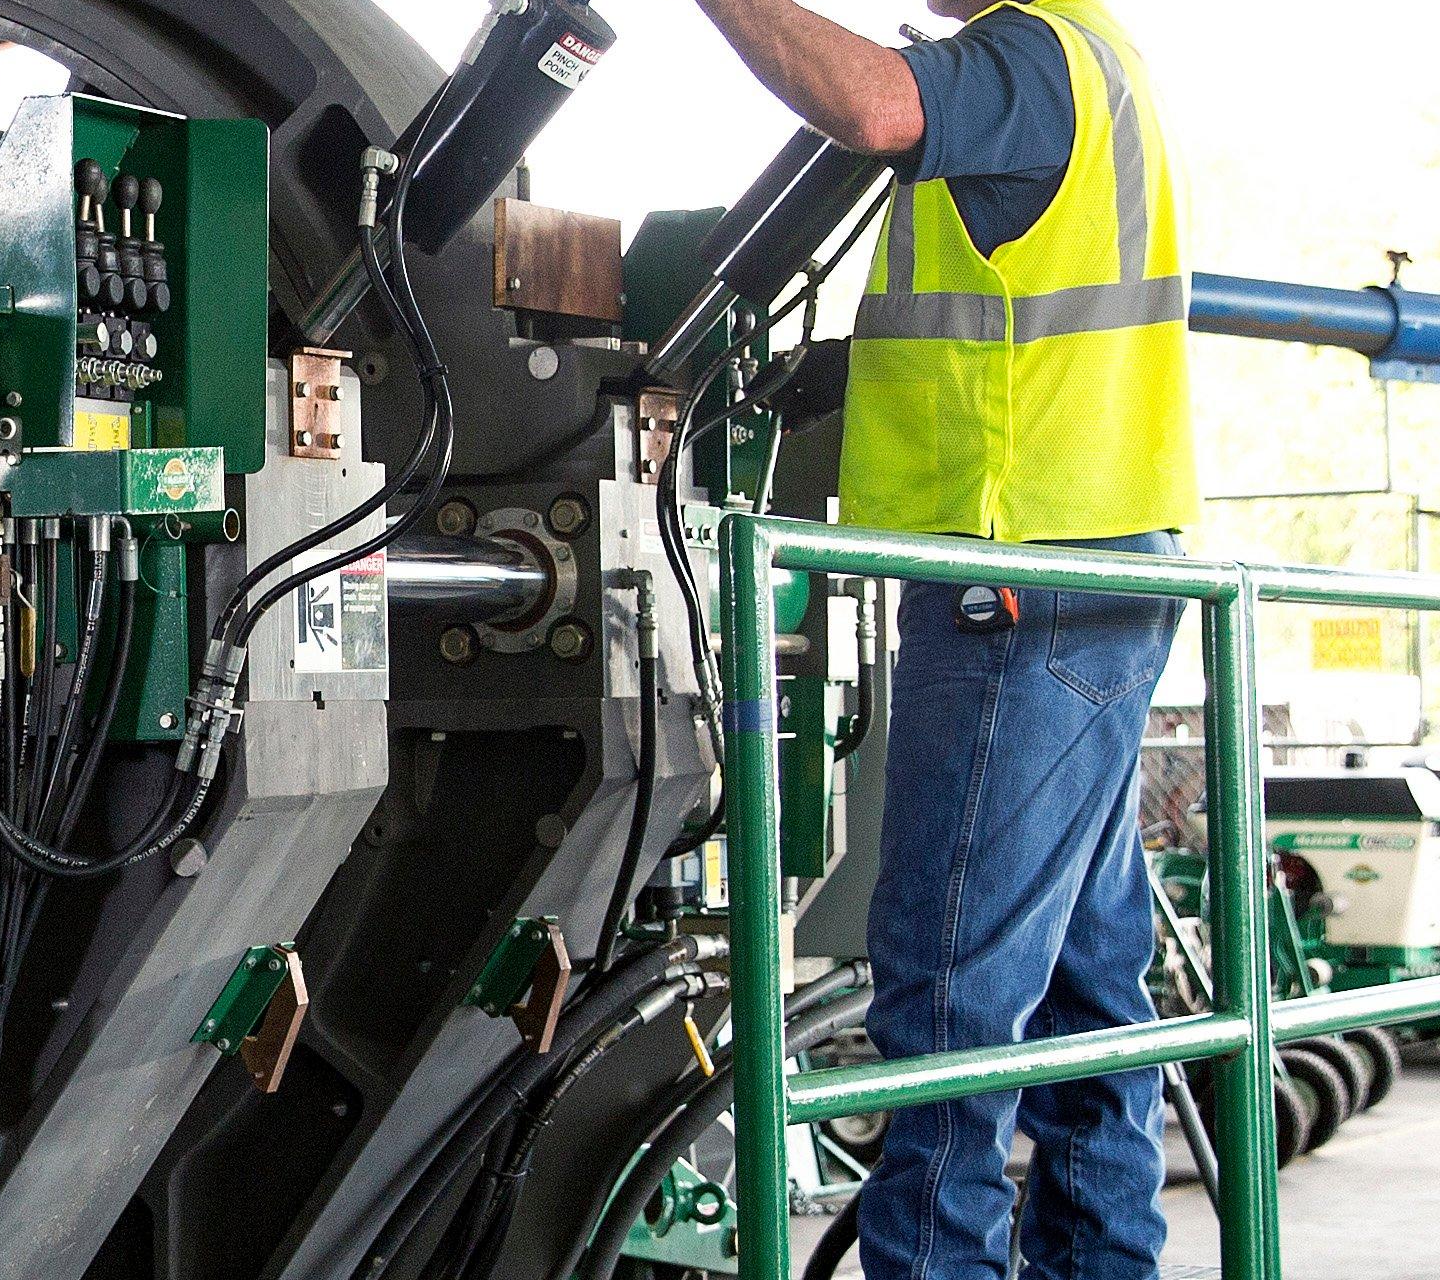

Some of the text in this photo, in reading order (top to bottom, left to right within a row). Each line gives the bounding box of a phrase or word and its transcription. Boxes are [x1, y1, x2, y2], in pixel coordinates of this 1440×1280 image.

[543, 60, 571, 80] POINT
[552, 50, 580, 72] PINCH
[157, 823, 186, 849] COVER
